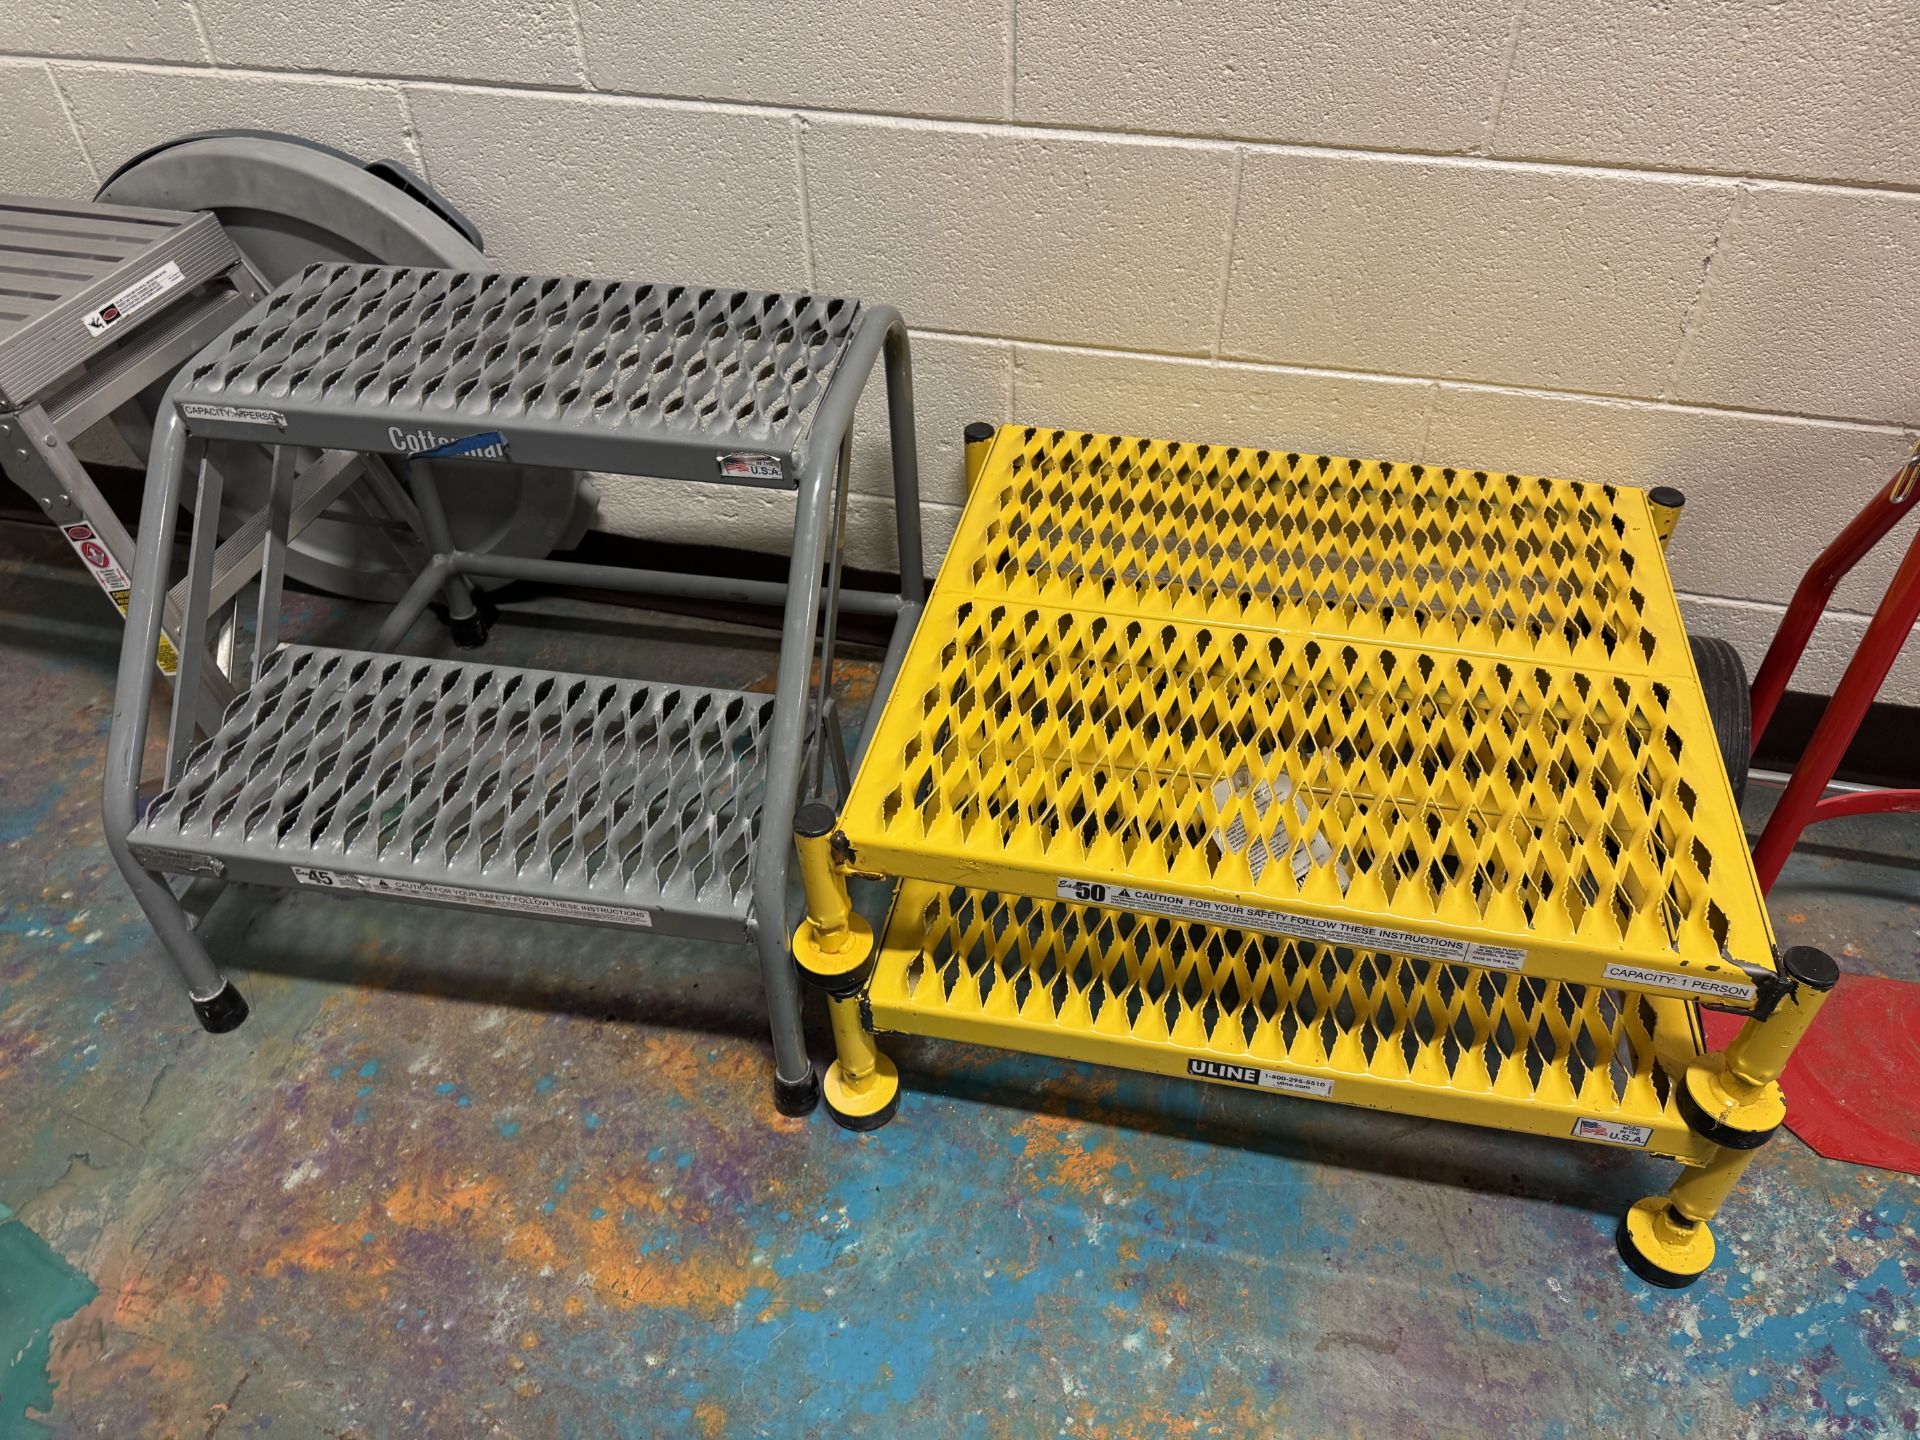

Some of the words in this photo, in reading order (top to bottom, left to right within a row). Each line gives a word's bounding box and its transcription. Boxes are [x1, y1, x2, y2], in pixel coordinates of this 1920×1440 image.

[751, 465, 782, 477] U.S.A.
[309, 869, 334, 886] 45
[395, 881, 433, 893] CAUTION
[433, 885, 452, 895] FOR
[454, 888, 478, 898] YOUR
[479, 892, 512, 902] SAFETY
[513, 895, 550, 907] FOLLOW
[552, 901, 581, 910] THESE
[581, 905, 645, 918] INSTRUCTIONS
[1135, 891, 1184, 905] CAUTION
[1189, 899, 1211, 910] FOR
[1214, 903, 1244, 915] YOUR
[1247, 908, 1288, 921] SAFETY
[1291, 916, 1337, 930] FOLLOW
[1340, 923, 1377, 936] THESE
[1379, 930, 1464, 950] INSTRUCTIONS
[1609, 967, 1678, 985] CAPACITY:
[1682, 978, 1688, 987] 1
[1691, 980, 1750, 997] PERSON
[1191, 1060, 1257, 1083] ULINE
[1264, 1073, 1326, 1088] 1-800-295-5510
[1609, 1132, 1645, 1144] U.S.A.
